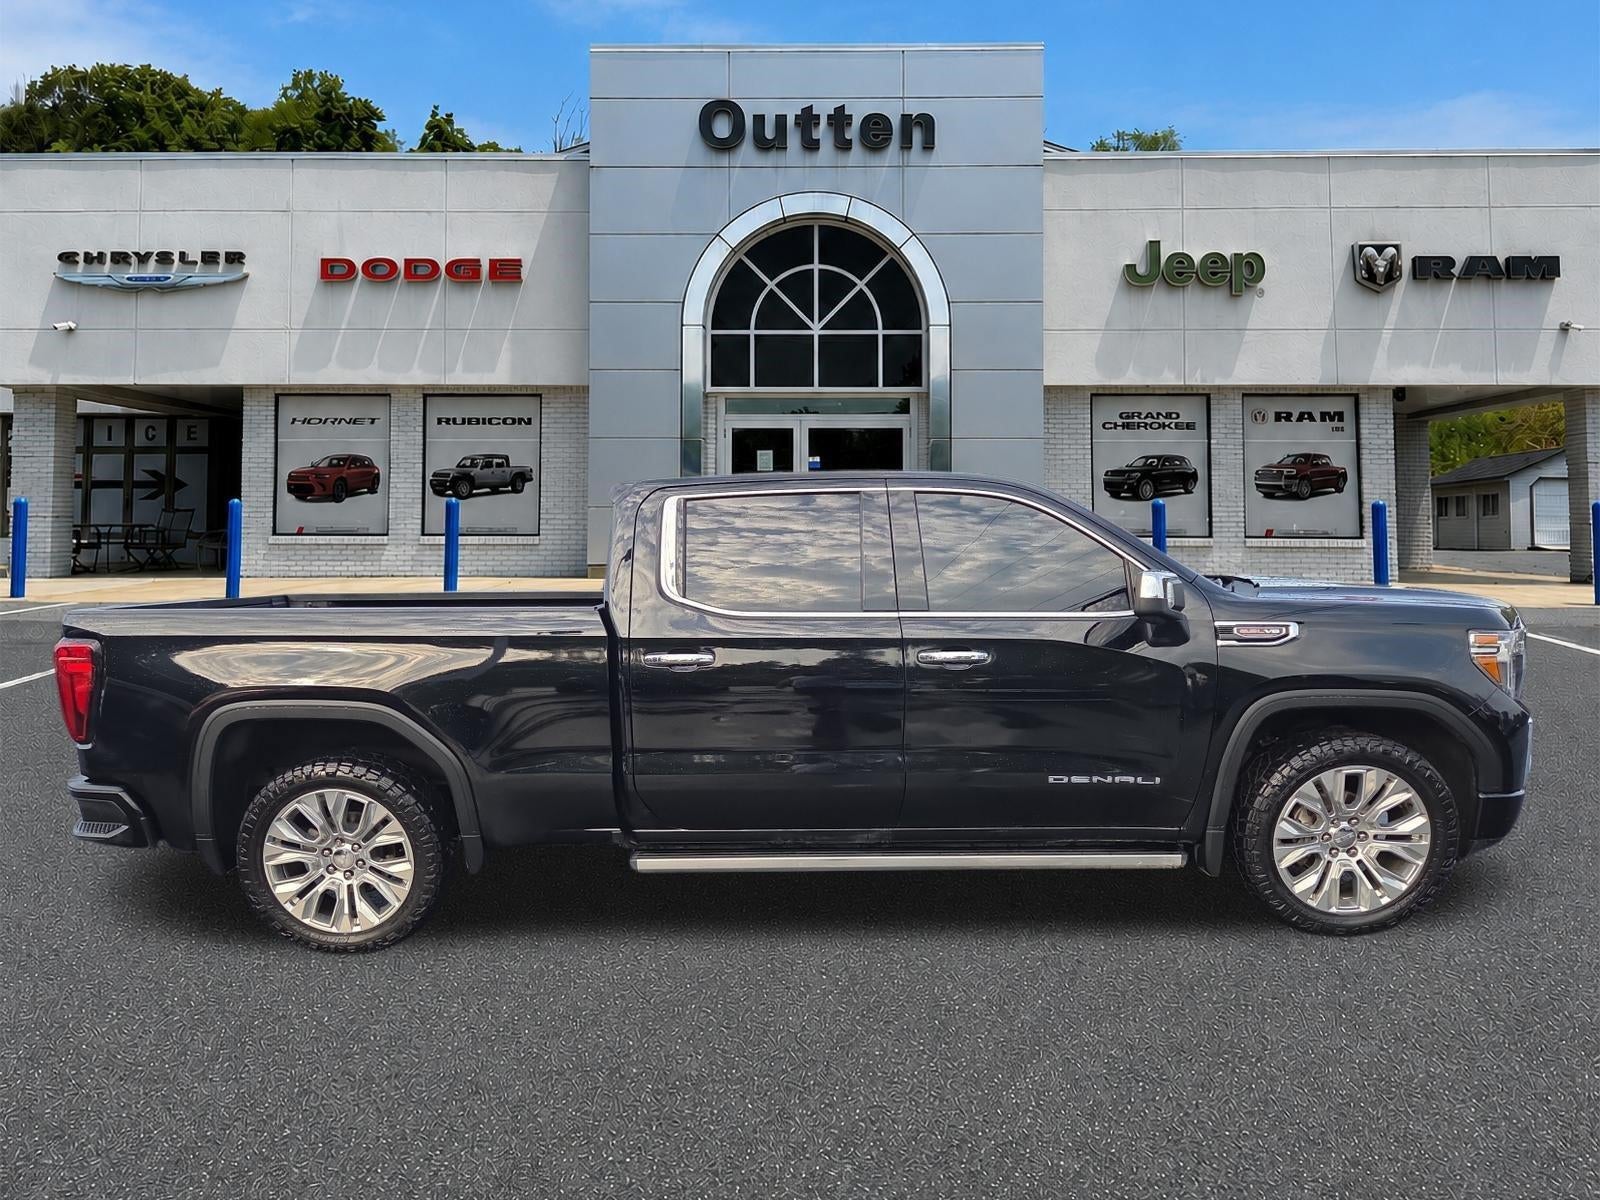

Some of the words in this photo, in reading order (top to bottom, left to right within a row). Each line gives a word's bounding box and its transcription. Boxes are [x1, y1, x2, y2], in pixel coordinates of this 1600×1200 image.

[699, 99, 936, 150] Outten
[57, 250, 247, 266] CHRYSLER
[320, 257, 523, 282] DODGE
[1123, 240, 1266, 297] Jeep
[1411, 255, 1561, 281] RAM
[290, 416, 381, 426] HORNET
[436, 416, 533, 426] RUBICON
[1118, 411, 1181, 420] GRAND
[1274, 411, 1345, 423] RAM
[1101, 421, 1197, 431] CHEROKEE
[1048, 775, 1160, 785] DENALI
